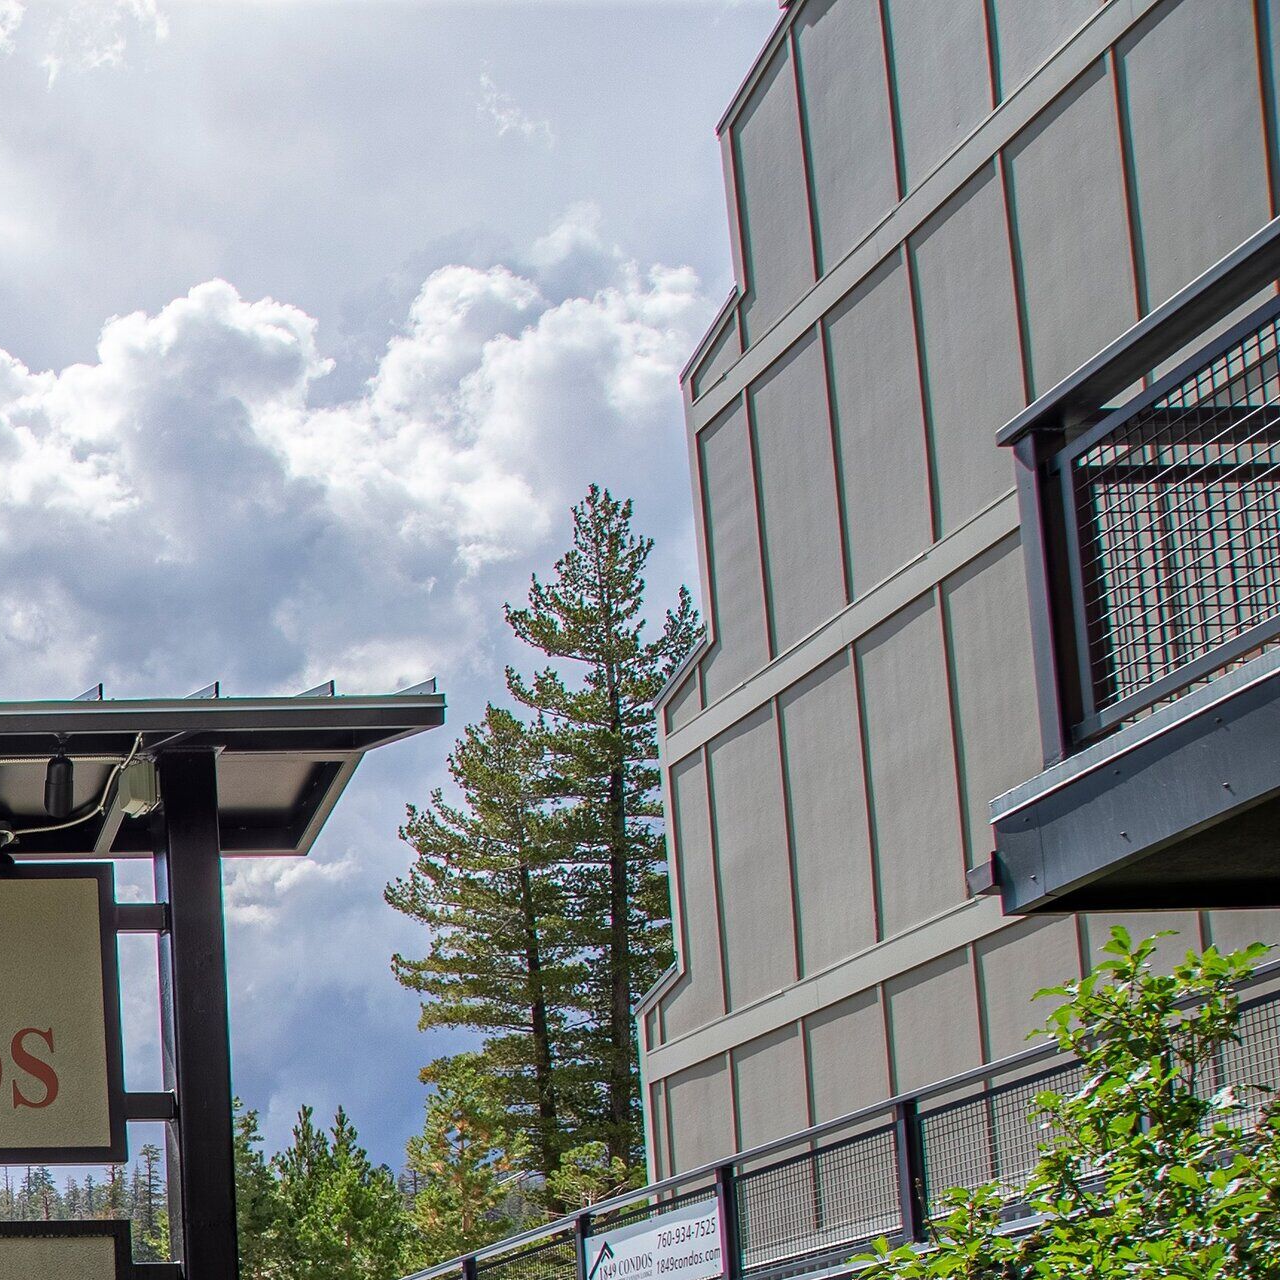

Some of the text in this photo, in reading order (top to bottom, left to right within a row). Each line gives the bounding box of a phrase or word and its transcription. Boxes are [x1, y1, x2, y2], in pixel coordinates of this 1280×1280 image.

[657, 1217, 716, 1249] 760-934-7525
[599, 1252, 653, 1280] 1849 CONDOS
[656, 1248, 720, 1274] 1849condos.com
